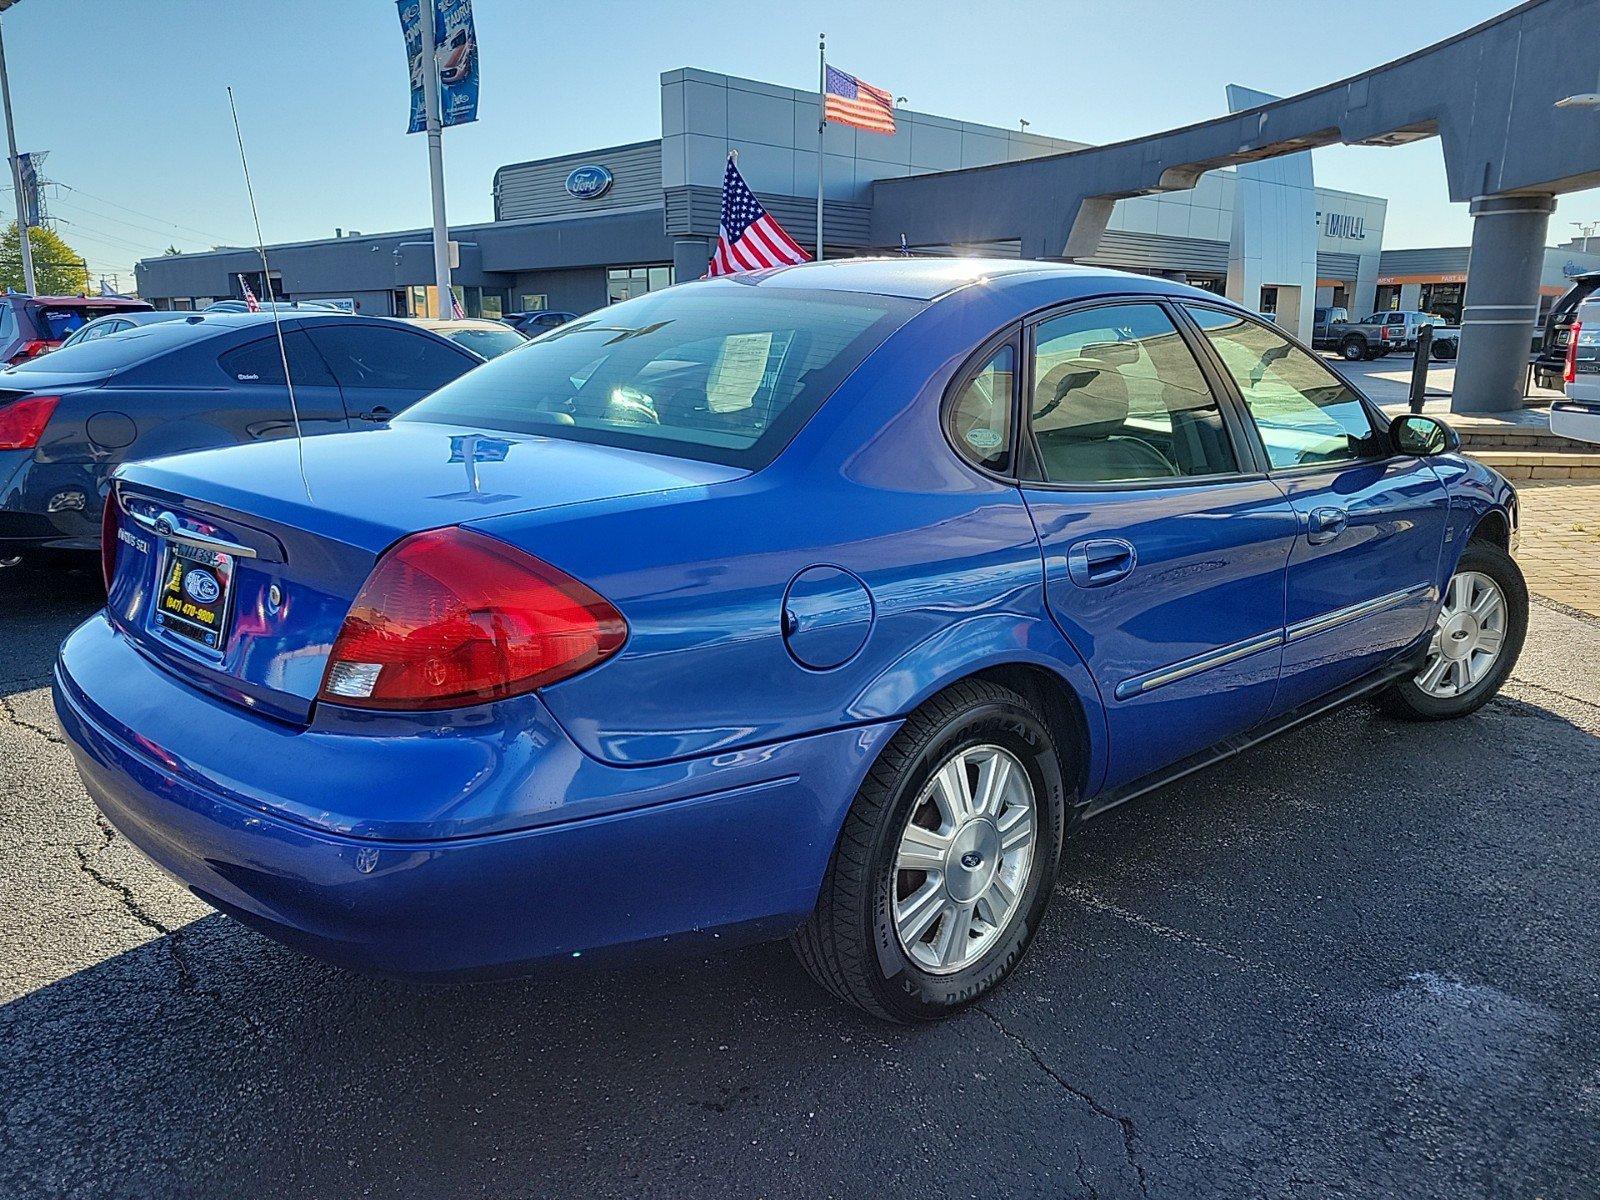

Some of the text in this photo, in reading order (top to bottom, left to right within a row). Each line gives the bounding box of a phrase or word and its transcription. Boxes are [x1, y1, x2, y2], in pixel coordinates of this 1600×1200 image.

[573, 173, 597, 191] Ford
[1325, 213, 1365, 239] MILL
[166, 596, 182, 612] (847)
